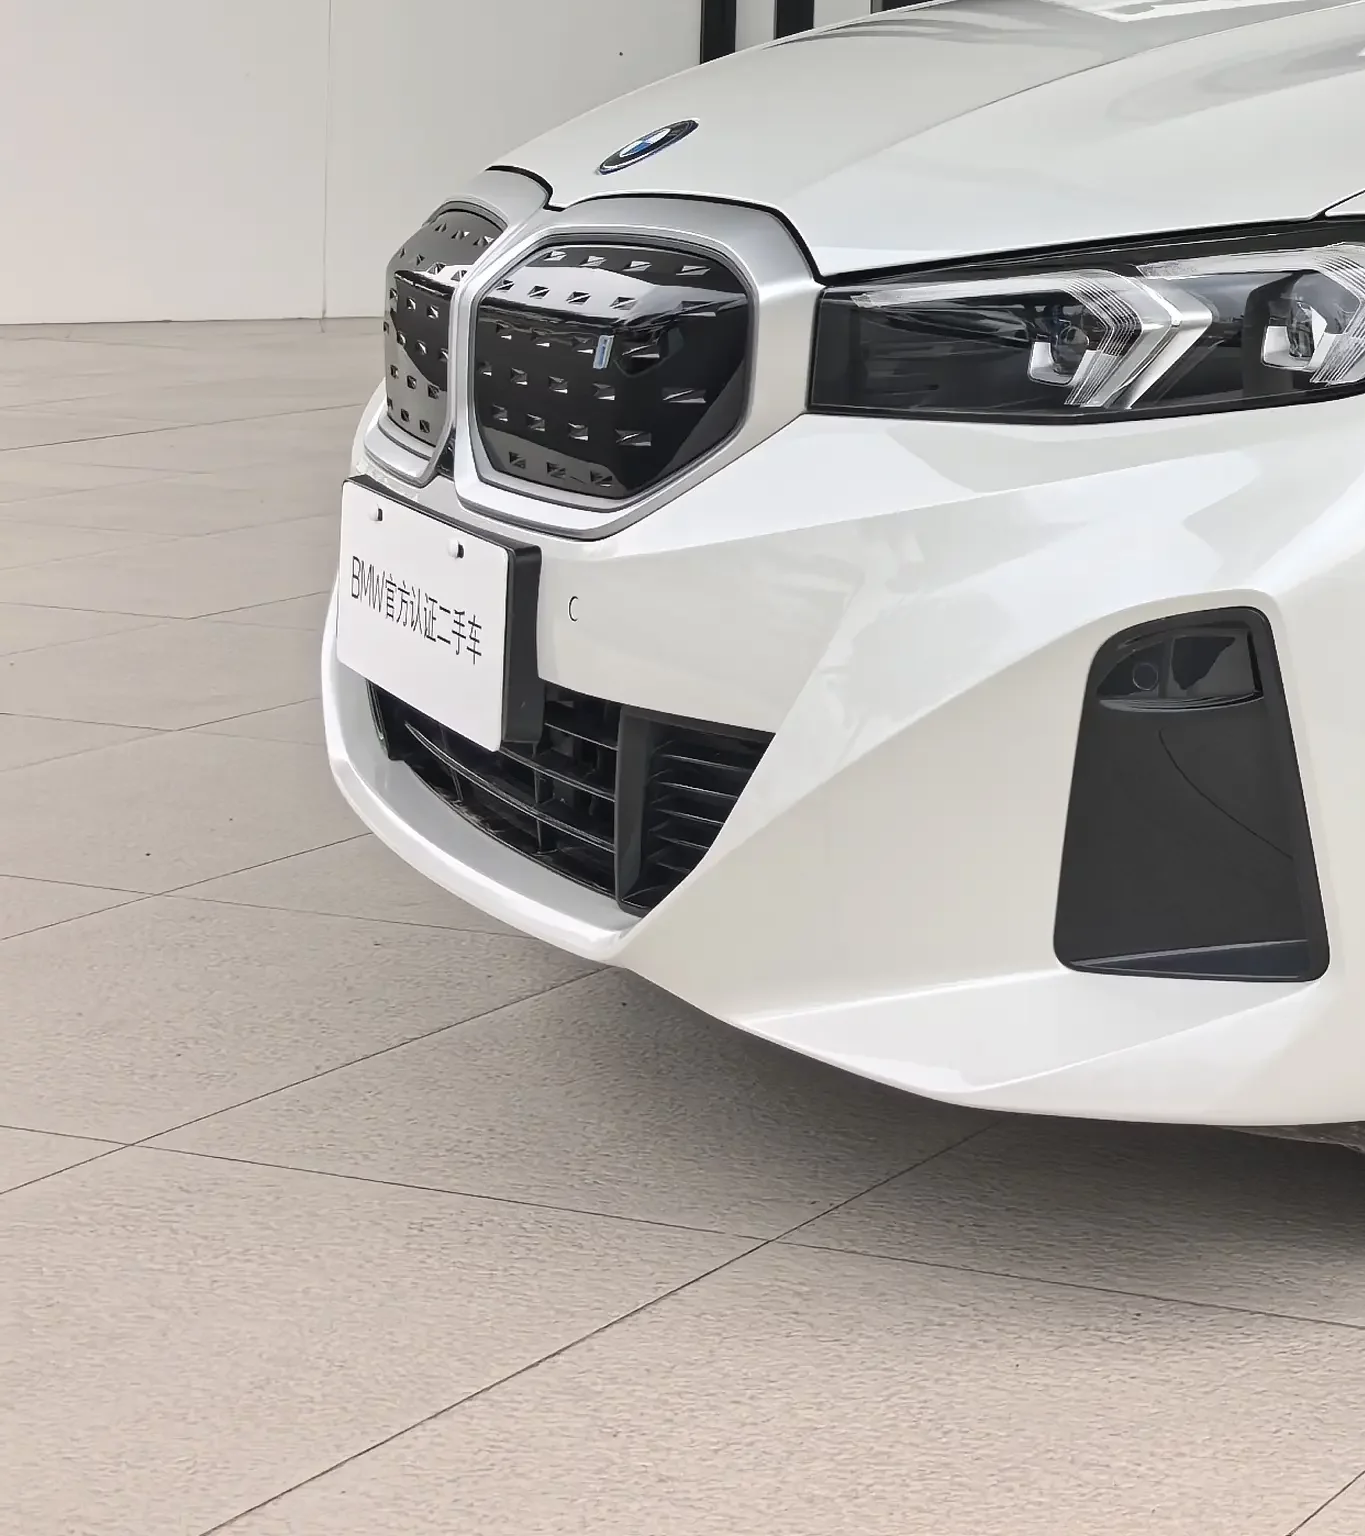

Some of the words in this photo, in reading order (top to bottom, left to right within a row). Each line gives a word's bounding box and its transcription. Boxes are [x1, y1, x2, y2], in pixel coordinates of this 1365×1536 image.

[351, 555, 482, 665] BMW官方认证二手车
